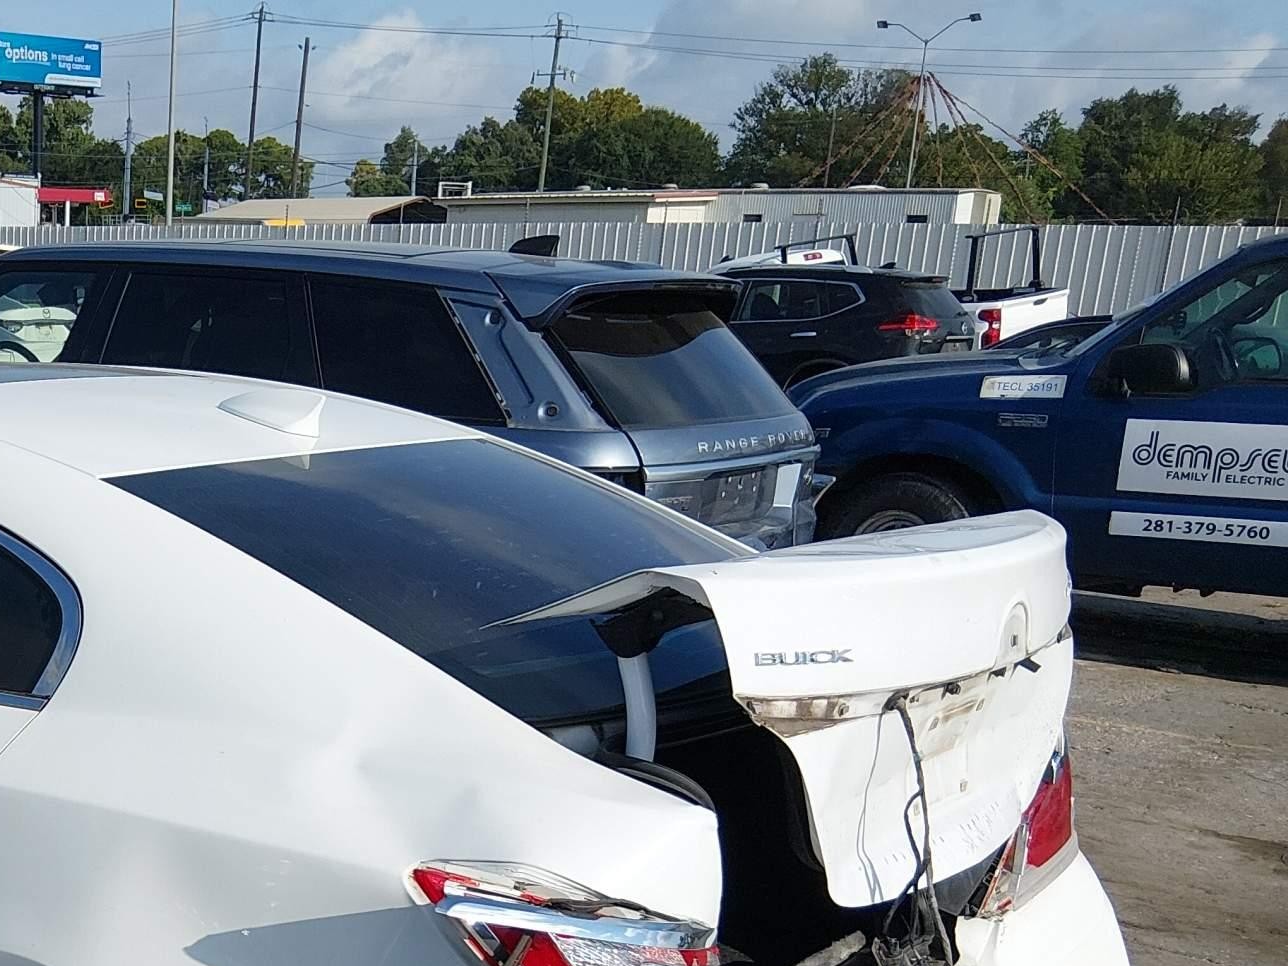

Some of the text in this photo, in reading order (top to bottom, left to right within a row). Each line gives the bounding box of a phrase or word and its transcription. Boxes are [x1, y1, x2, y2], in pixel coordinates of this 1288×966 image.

[5, 45, 48, 63] options
[996, 381, 1059, 392] TECL 35191
[697, 437, 759, 453] RANGE
[1132, 431, 1288, 483] dempse
[1165, 471, 1285, 487] FAMILY ELECTRIC
[1142, 518, 1271, 540] 281-379-5760
[754, 649, 854, 666] BUICK
